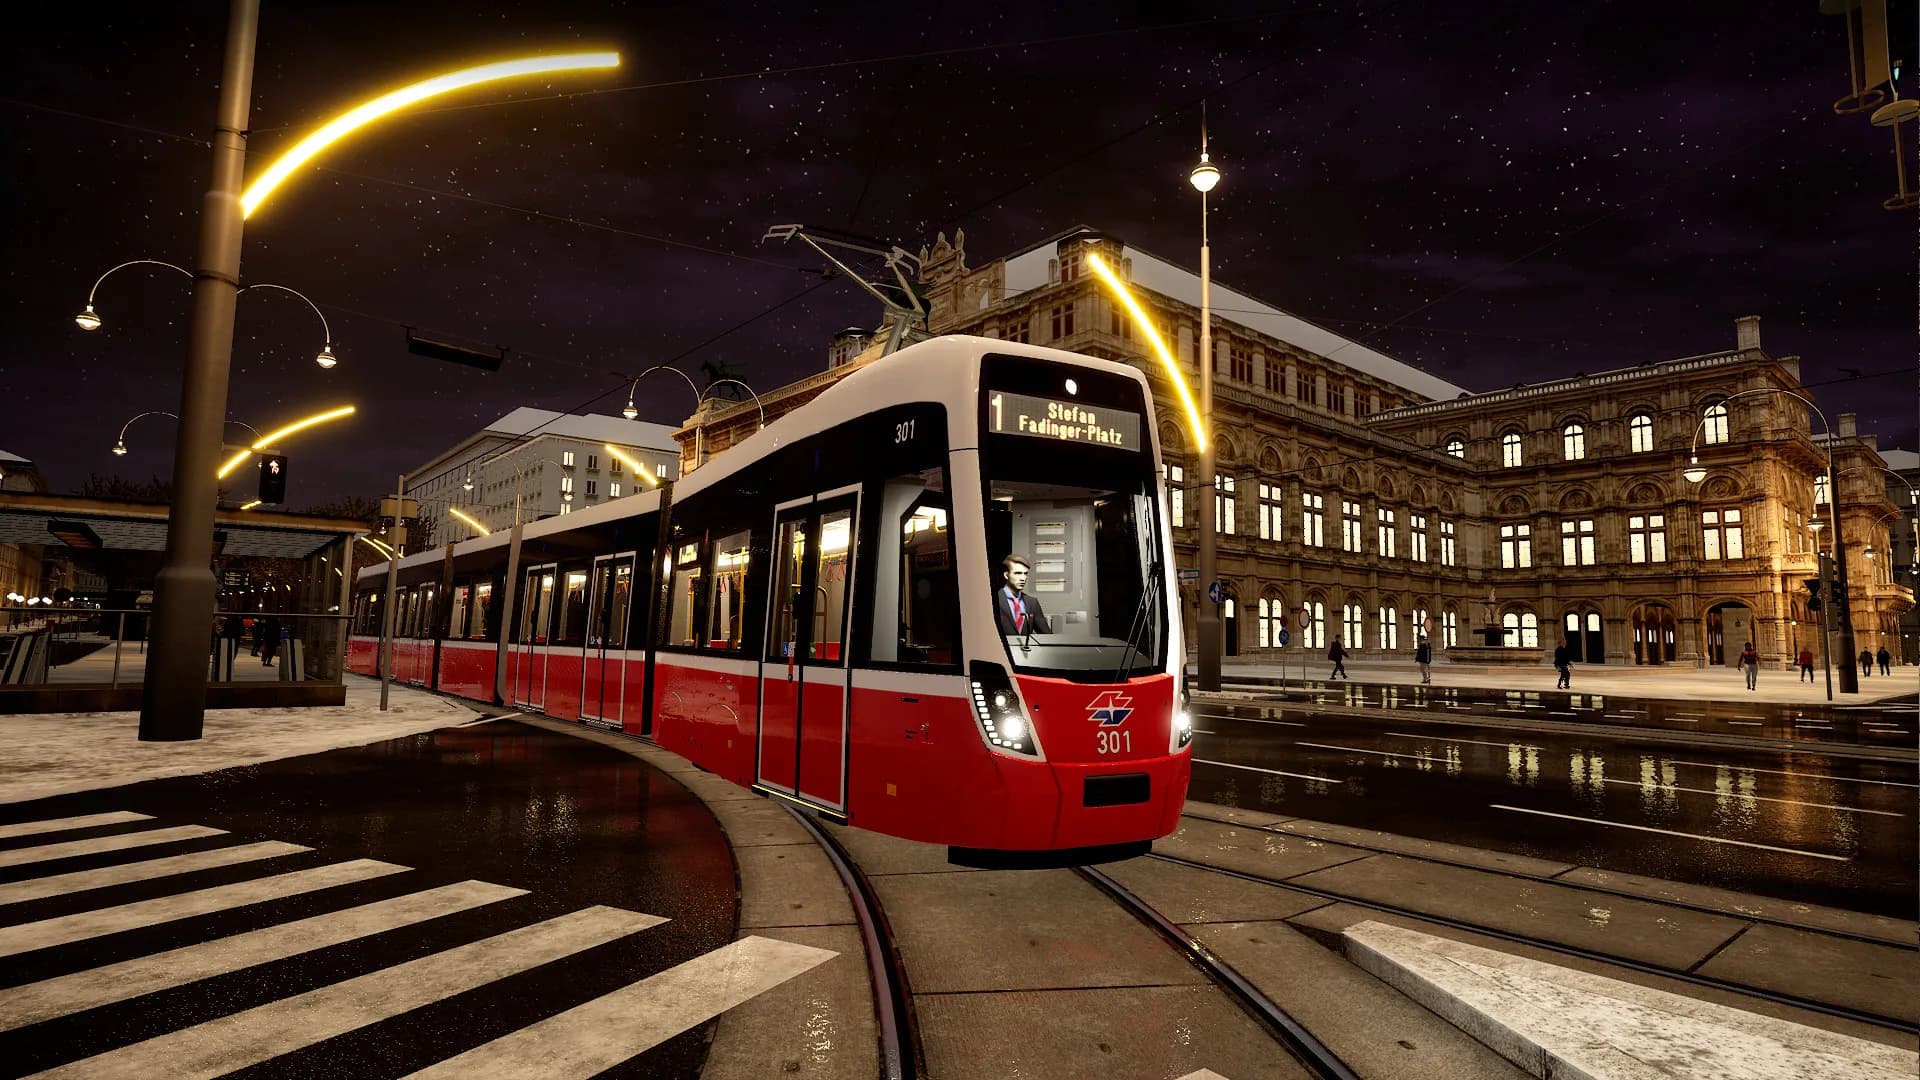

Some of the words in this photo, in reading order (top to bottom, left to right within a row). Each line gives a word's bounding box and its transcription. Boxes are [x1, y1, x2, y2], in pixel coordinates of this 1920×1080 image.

[991, 394, 1003, 431] 1
[1048, 402, 1096, 425] Stefan
[895, 419, 915, 444] 301
[1019, 414, 1122, 445] Fadinger-Platz
[1096, 730, 1131, 754] 301
